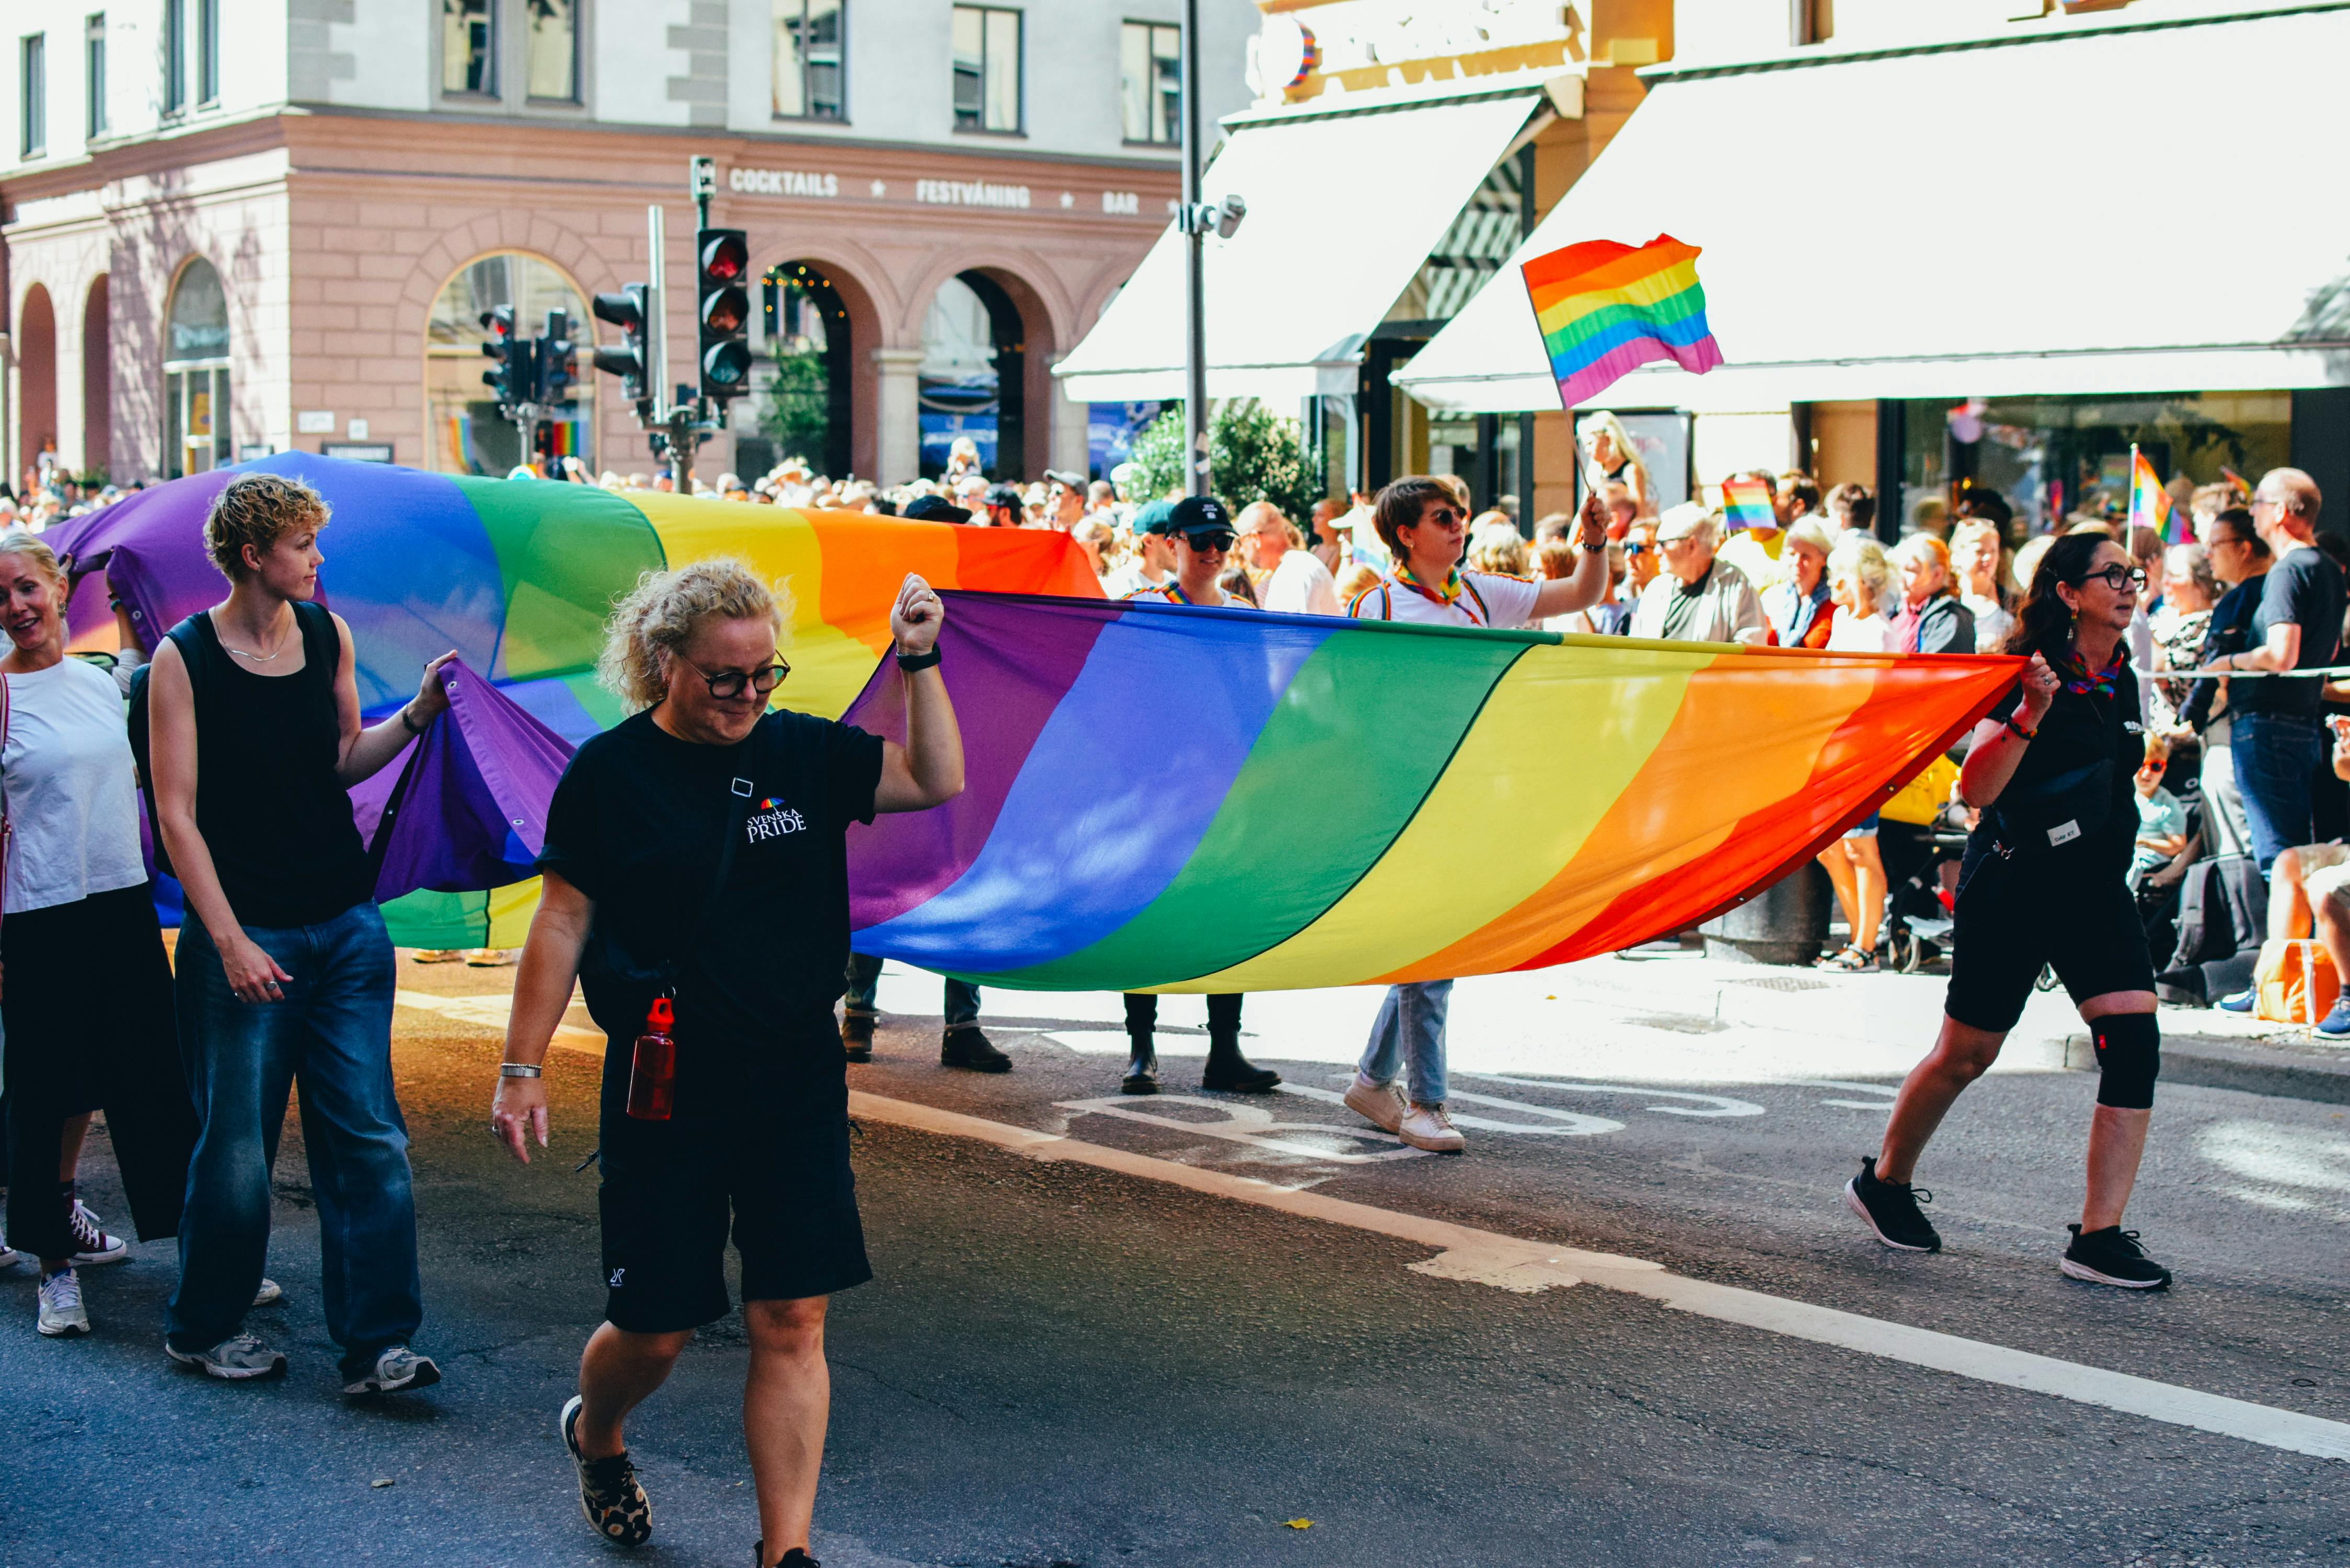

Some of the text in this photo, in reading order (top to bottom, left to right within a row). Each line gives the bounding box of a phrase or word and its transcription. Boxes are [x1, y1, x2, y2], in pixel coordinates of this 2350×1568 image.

[730, 168, 838, 197] COCKTAILS
[1102, 191, 1139, 214] BAR
[746, 815, 807, 844] PRIDE
[747, 809, 799, 827] SVENSKA
